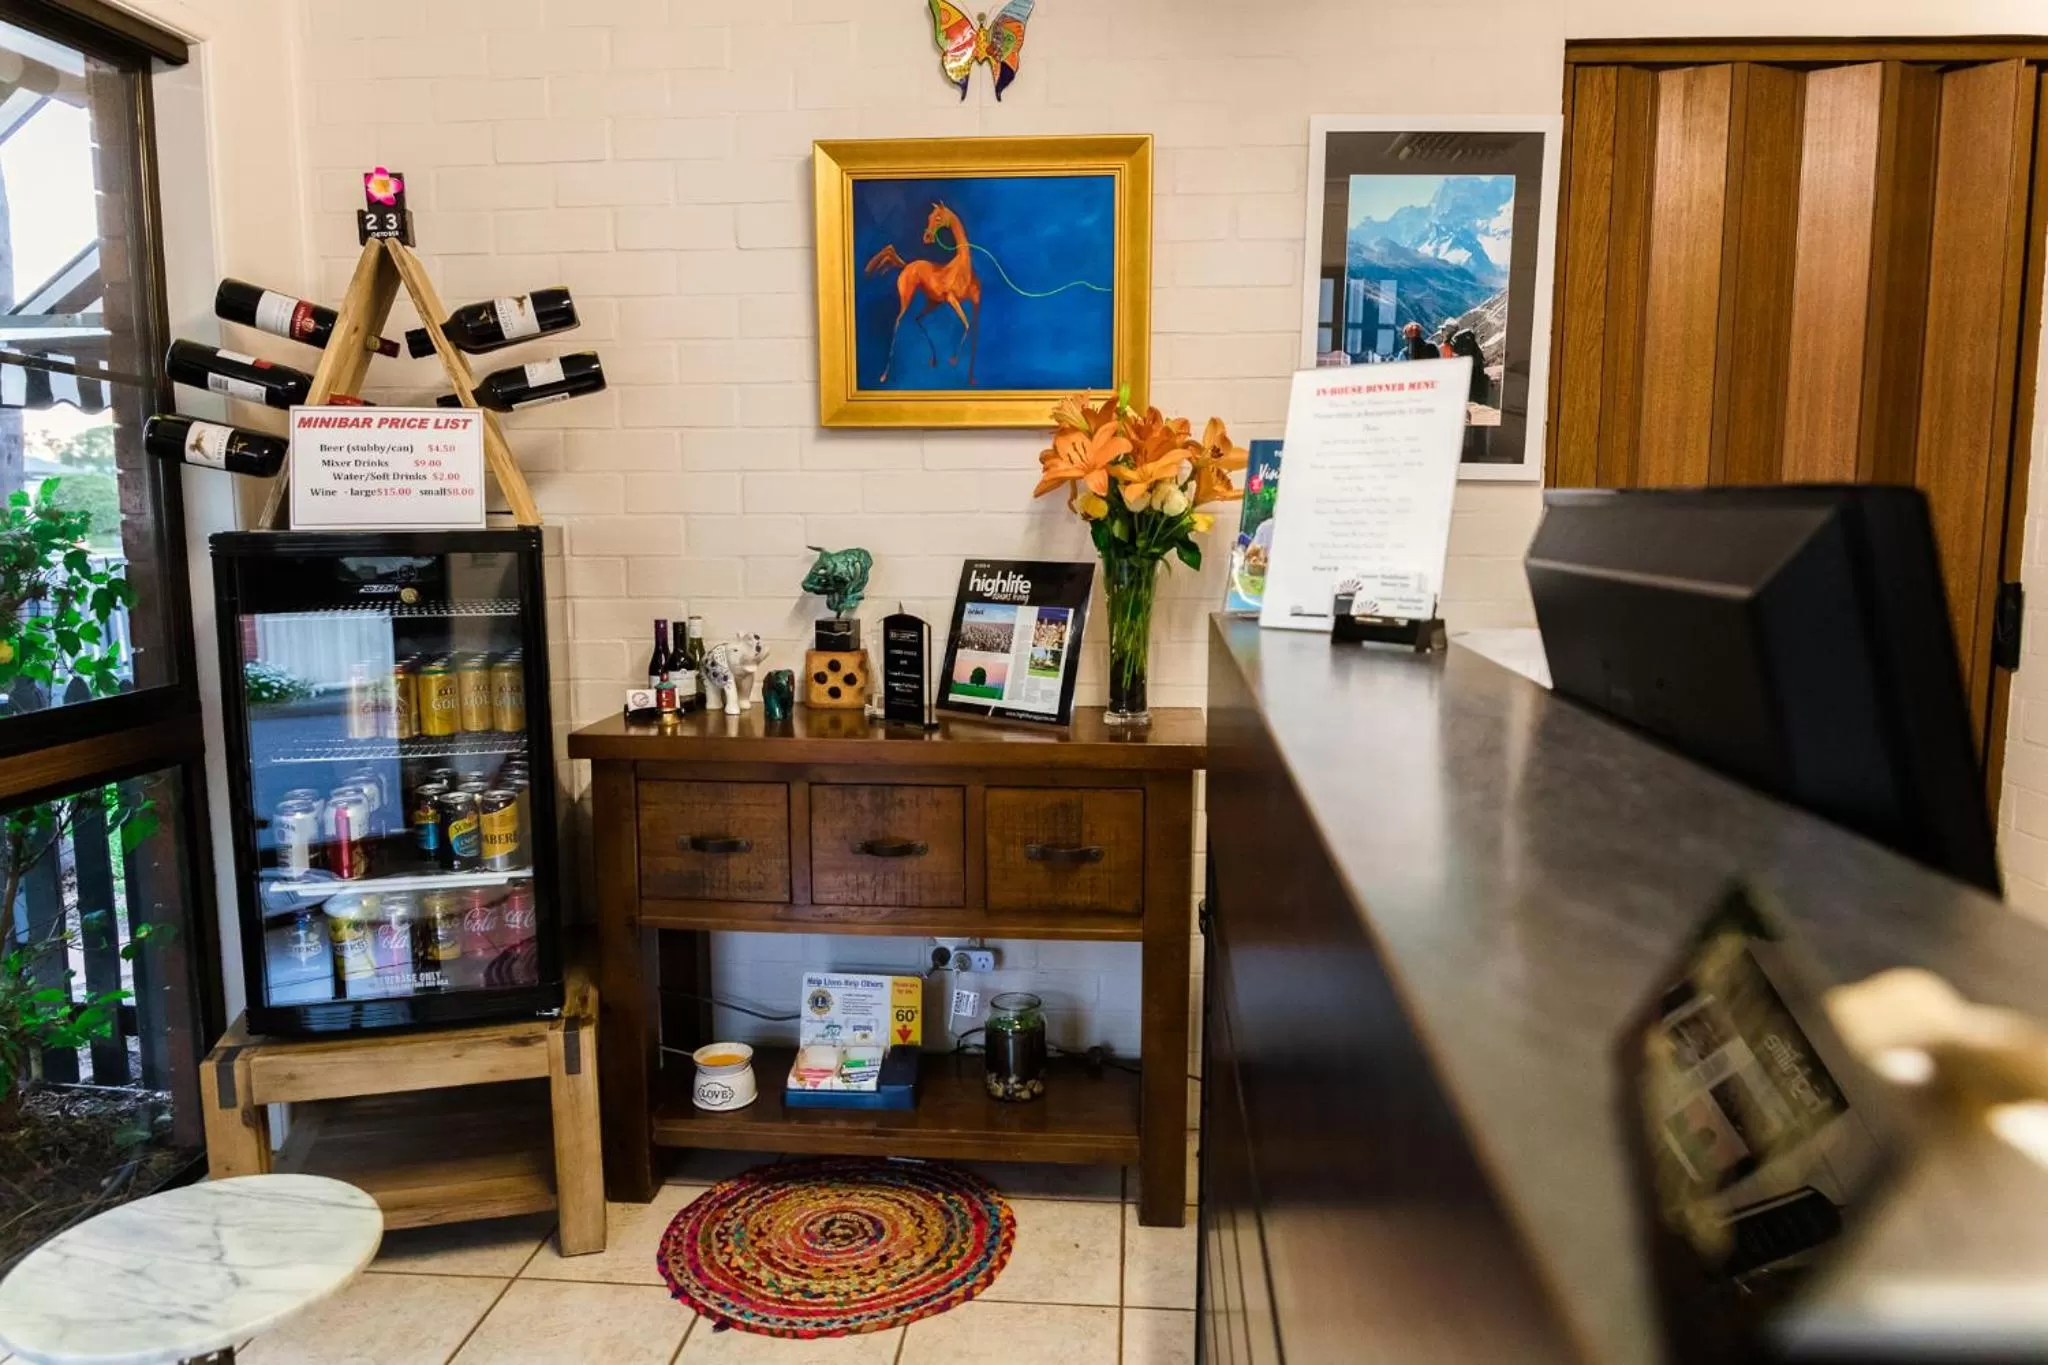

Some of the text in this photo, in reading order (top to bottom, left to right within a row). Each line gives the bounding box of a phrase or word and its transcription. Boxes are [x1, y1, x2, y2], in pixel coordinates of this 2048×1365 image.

[1366, 382, 1405, 394] DINNER
[297, 416, 473, 430] MINIBAR PRICE LIST
[319, 443, 456, 454] Beer (stubby/can) $4.50
[321, 459, 351, 468] Mixer
[354, 459, 389, 468] Drinks
[332, 471, 461, 482] Water/Soft Drinks $2.00
[310, 487, 338, 497] Wine
[969, 570, 1031, 597] highlife
[701, 1089, 729, 1099] LOVE
